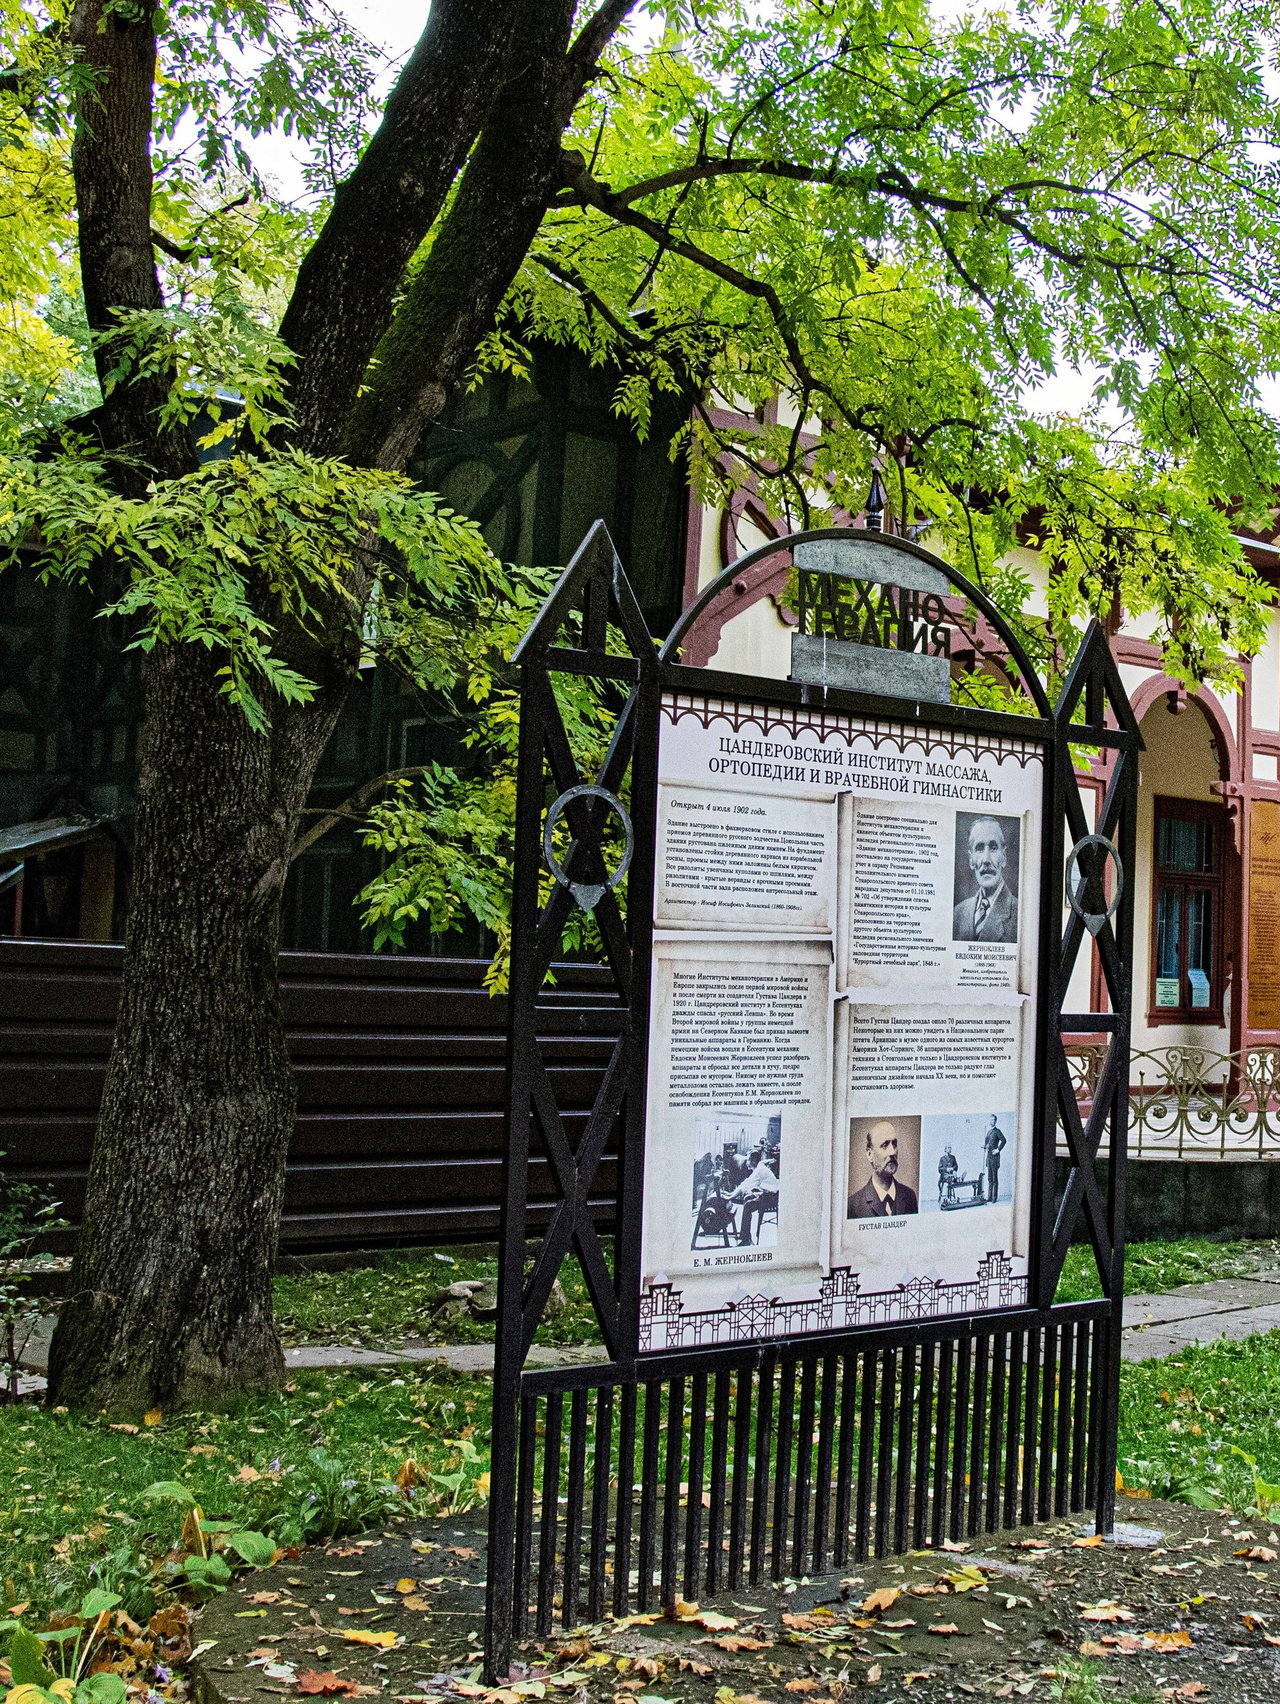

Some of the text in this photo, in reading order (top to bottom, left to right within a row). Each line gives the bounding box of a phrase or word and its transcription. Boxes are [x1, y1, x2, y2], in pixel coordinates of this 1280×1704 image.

[798, 570, 946, 627] МЕХАНО
[792, 600, 951, 660] ТЕРАПИЯ
[708, 757, 1003, 803] ОРТОПЕДИИ И ВРАЧЕБНОЙ ГИМНАСТИКИ
[718, 737, 993, 784] ЦАНДЕРОВСКИЙ ИНСТИТУТ МАССАЖА,
[671, 799, 768, 817] Открыт 4 июля 1902 года.
[858, 1220, 908, 1231] ГУСТАВ ЦАНДЕР
[693, 1252, 774, 1267] Е. М. ЖЕРНОКЛЕЕВ
